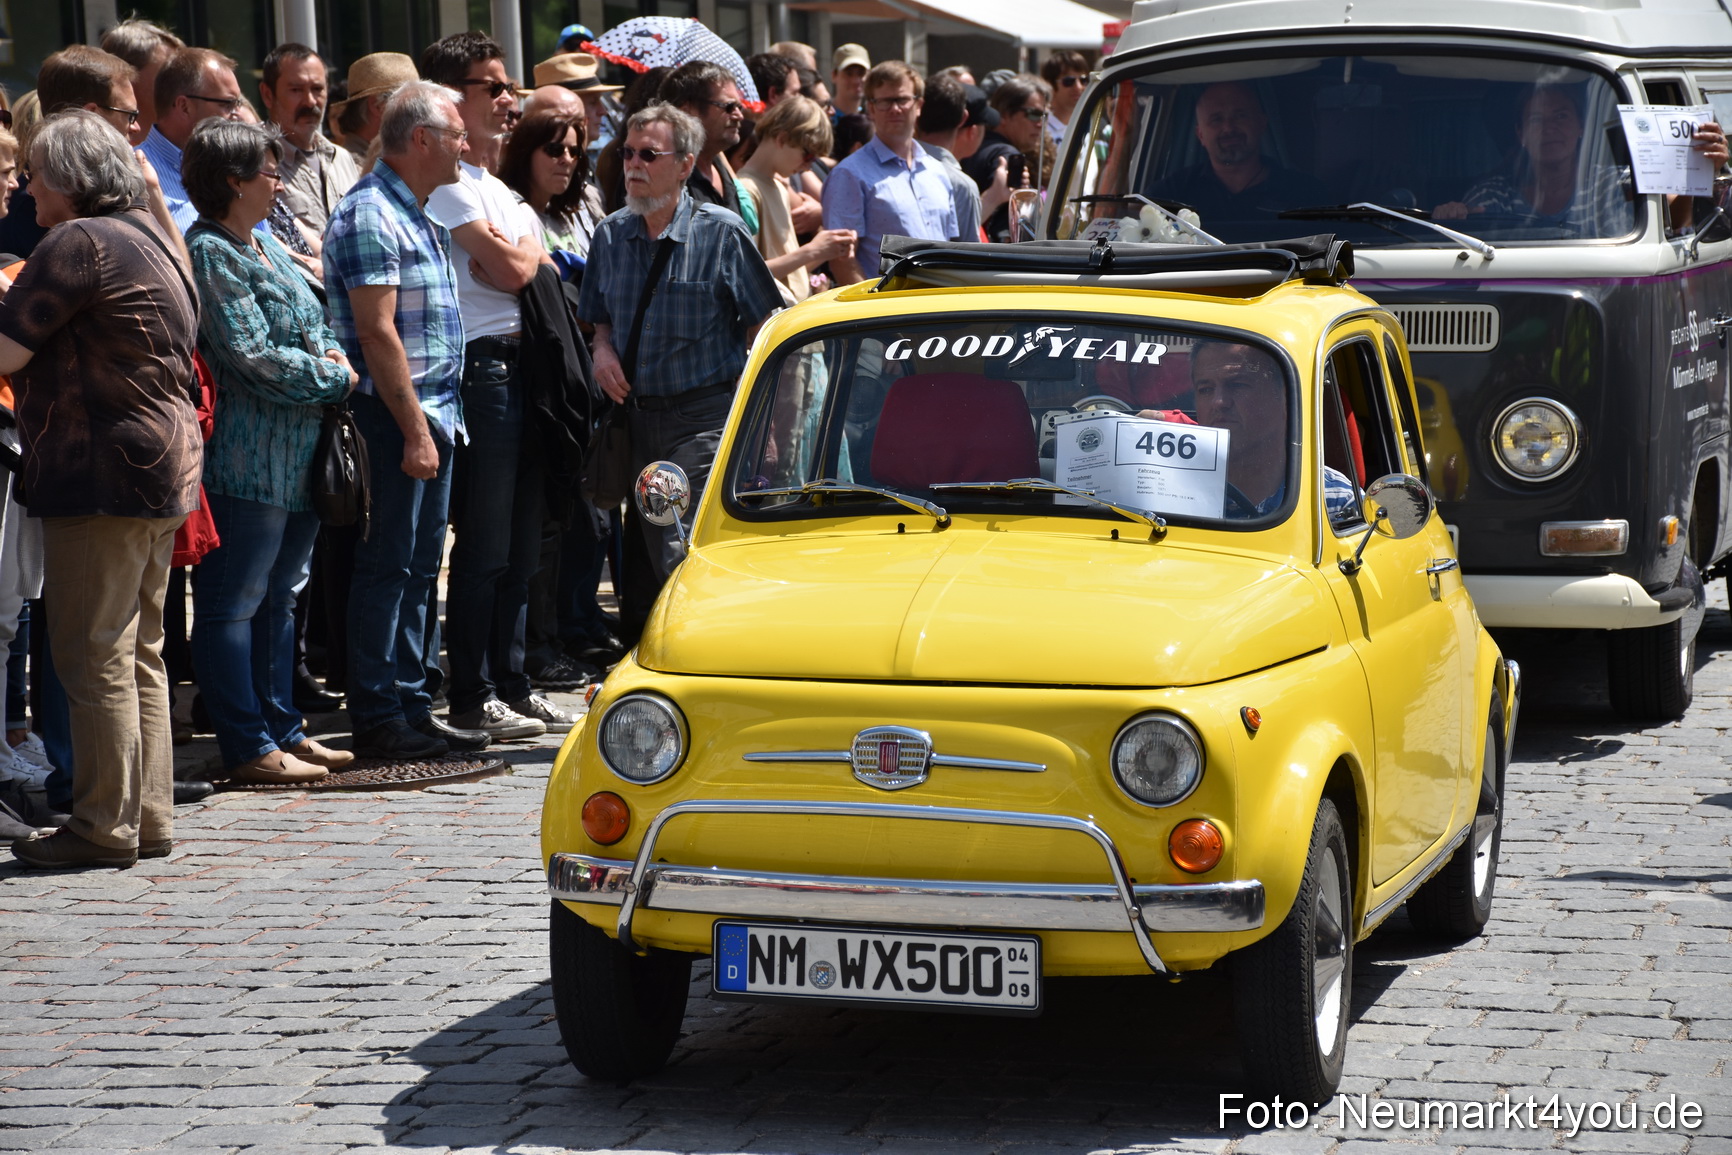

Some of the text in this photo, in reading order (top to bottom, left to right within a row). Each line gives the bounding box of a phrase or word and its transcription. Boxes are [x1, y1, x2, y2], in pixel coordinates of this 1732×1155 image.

[1671, 326, 1689, 346] RECHTS
[1135, 431, 1197, 460] 466
[1067, 474, 1092, 482] Teilnehmer
[881, 744, 897, 772] FIAT
[1007, 947, 1029, 963] 04
[727, 965, 738, 979] D
[748, 934, 806, 987] NM
[837, 938, 1003, 997] WX500
[1008, 982, 1030, 998] 09
